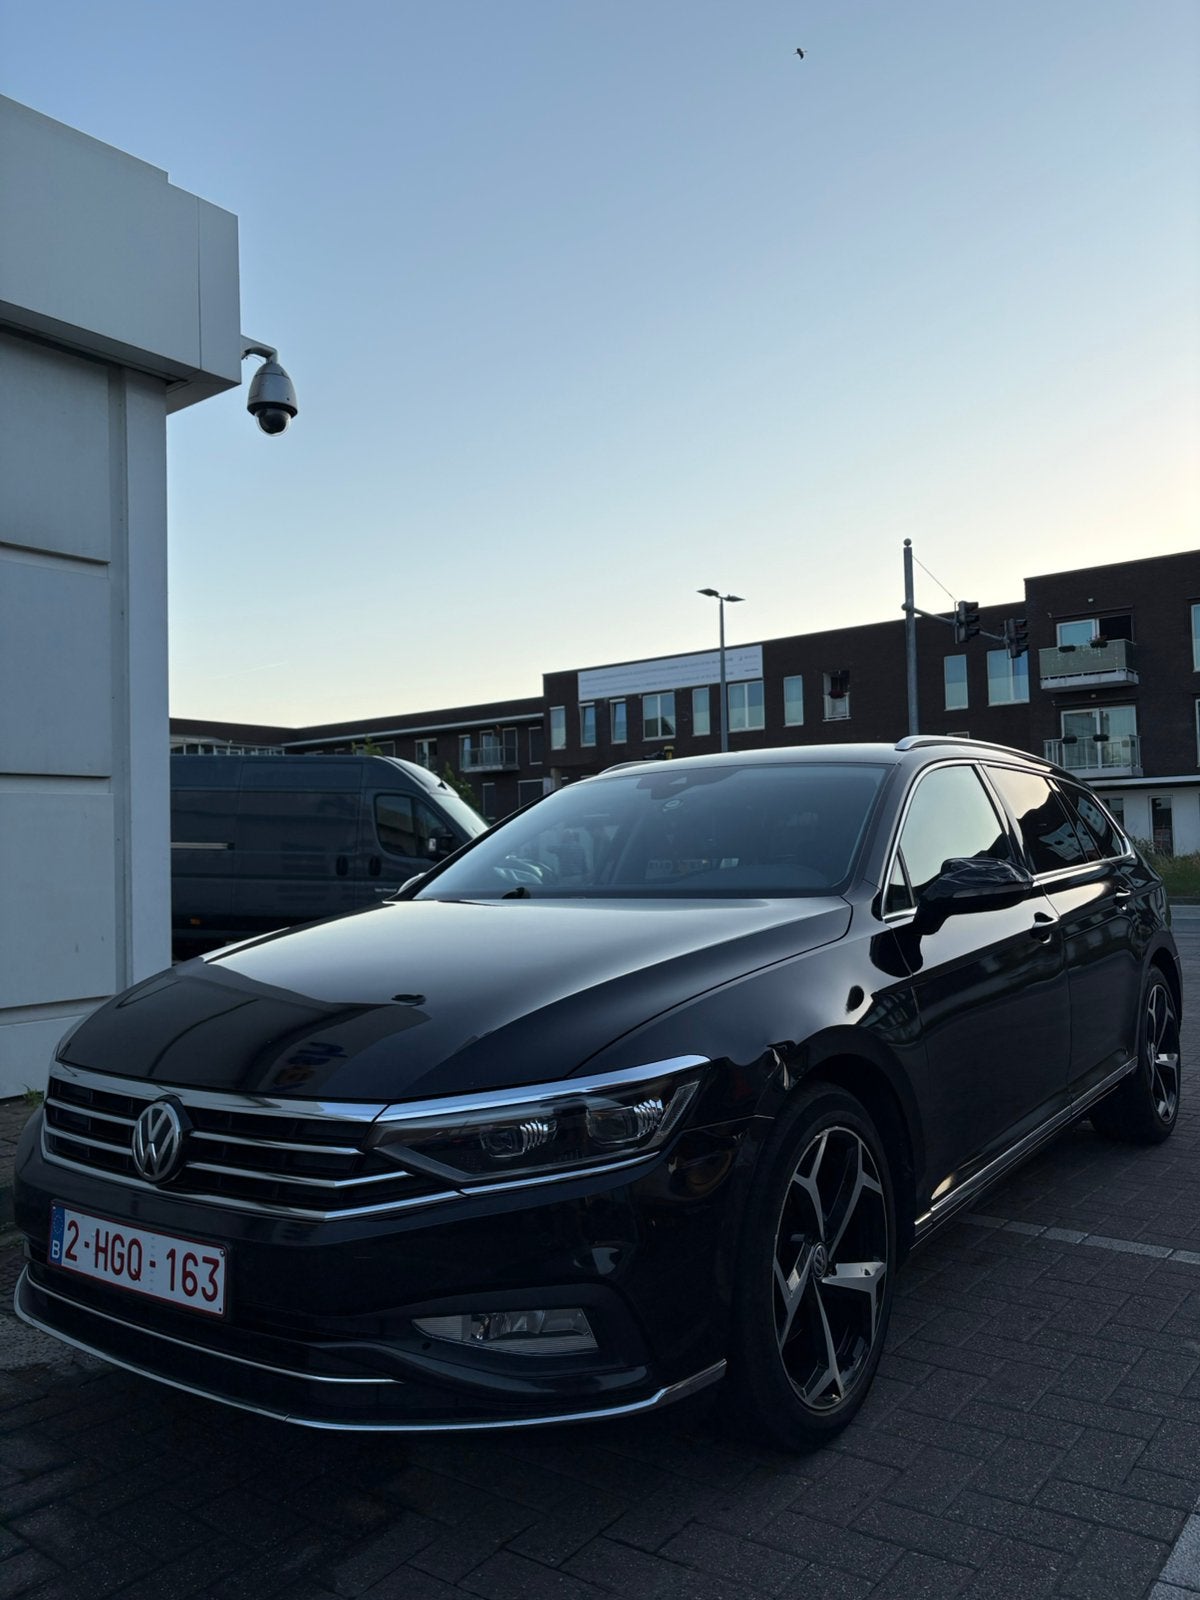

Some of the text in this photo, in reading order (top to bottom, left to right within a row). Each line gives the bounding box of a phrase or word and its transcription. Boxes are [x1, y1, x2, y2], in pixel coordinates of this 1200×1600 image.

[132, 1101, 181, 1180] VW
[52, 1240, 61, 1259] B
[64, 1219, 220, 1302] 2-HGQ-163
